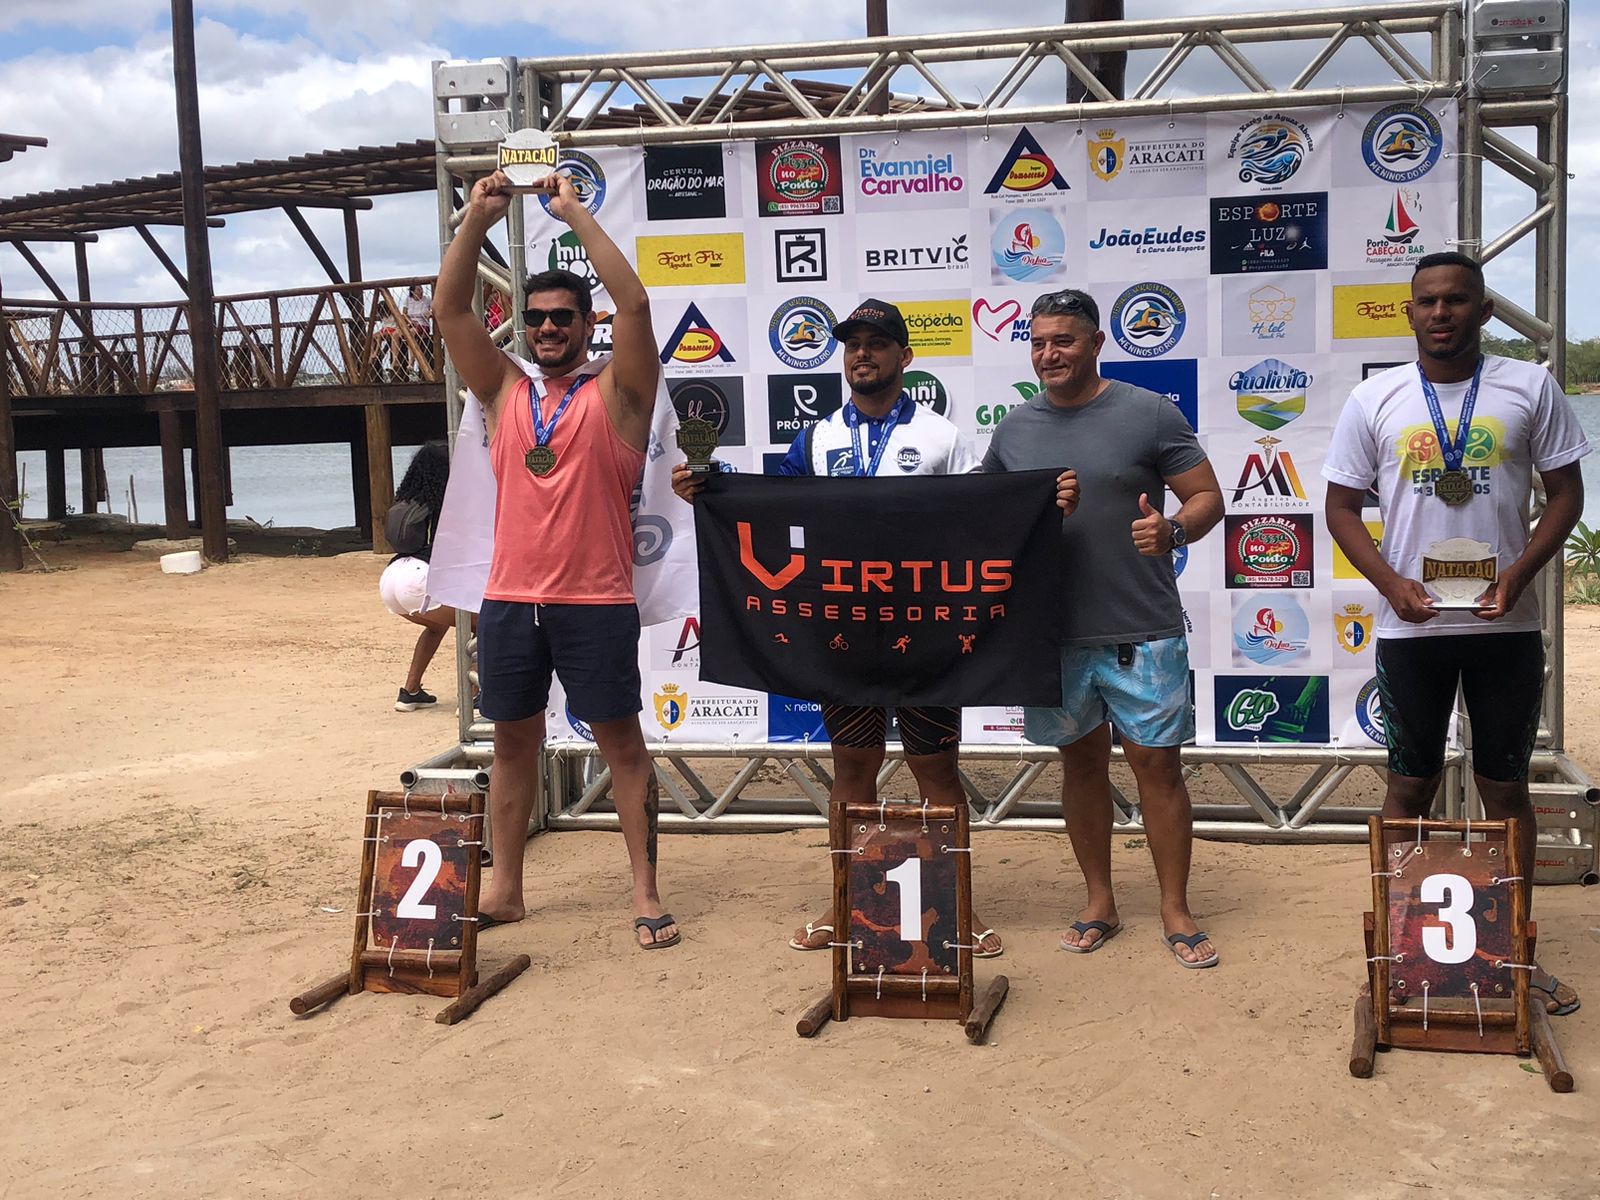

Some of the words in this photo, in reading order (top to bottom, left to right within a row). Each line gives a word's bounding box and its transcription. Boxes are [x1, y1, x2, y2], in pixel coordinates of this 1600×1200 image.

[1129, 143, 1187, 153] PREFEITURA
[1227, 132, 1242, 158] Equipe
[1297, 123, 1314, 153] Abertas
[859, 148, 875, 158] Dr
[1129, 149, 1205, 165] ARACATI
[779, 155, 818, 170] Pizza
[860, 154, 952, 178] Evanniel
[663, 168, 703, 176] CERVEJA
[781, 170, 796, 178] no
[1369, 160, 1406, 183] MENINOS
[1406, 169, 1420, 181] DO
[1419, 160, 1433, 176] RIO
[647, 175, 686, 191] DRAGÃO
[687, 177, 702, 189] DO
[703, 176, 724, 188] MAR
[780, 180, 818, 190] Ponto
[859, 173, 963, 195] Carvalho
[1089, 225, 1206, 250] JoãoEudes
[1250, 226, 1286, 242] LUZ
[1176, 244, 1206, 253] Esporte
[1366, 238, 1389, 247] Porto
[1366, 243, 1405, 256] CABEÇÃO
[1408, 245, 1424, 254] BAR
[657, 251, 692, 266] Fort
[694, 250, 725, 265] Fix
[866, 245, 969, 266] BRITVIC
[1260, 249, 1274, 257] FILA
[1366, 255, 1392, 264] Passagem
[1393, 254, 1403, 262] das
[947, 261, 969, 270] brasil
[1356, 302, 1396, 316] Fort
[903, 313, 963, 331] rtopedia
[1117, 336, 1153, 357] MENINOS
[1153, 345, 1166, 356] DO
[1165, 336, 1178, 352] RIO
[776, 348, 809, 369] MENINOS
[808, 359, 821, 369] DO
[819, 349, 832, 364] RIO
[777, 417, 801, 430] PRÓ
[1412, 466, 1490, 484] ESPTE
[1426, 486, 1434, 496] 3
[1241, 516, 1296, 531] PIZZARIA
[1249, 530, 1287, 544] Pizza
[1250, 544, 1265, 552] no
[737, 521, 1012, 593] VIRTUS
[1248, 553, 1288, 563] Ponto
[746, 595, 1006, 621] ASSESSORIA
[691, 706, 758, 718] ARACATI
[572, 721, 595, 740] MENIN
[397, 838, 442, 920] 2
[886, 857, 921, 941] 1
[1420, 873, 1477, 964] 3
